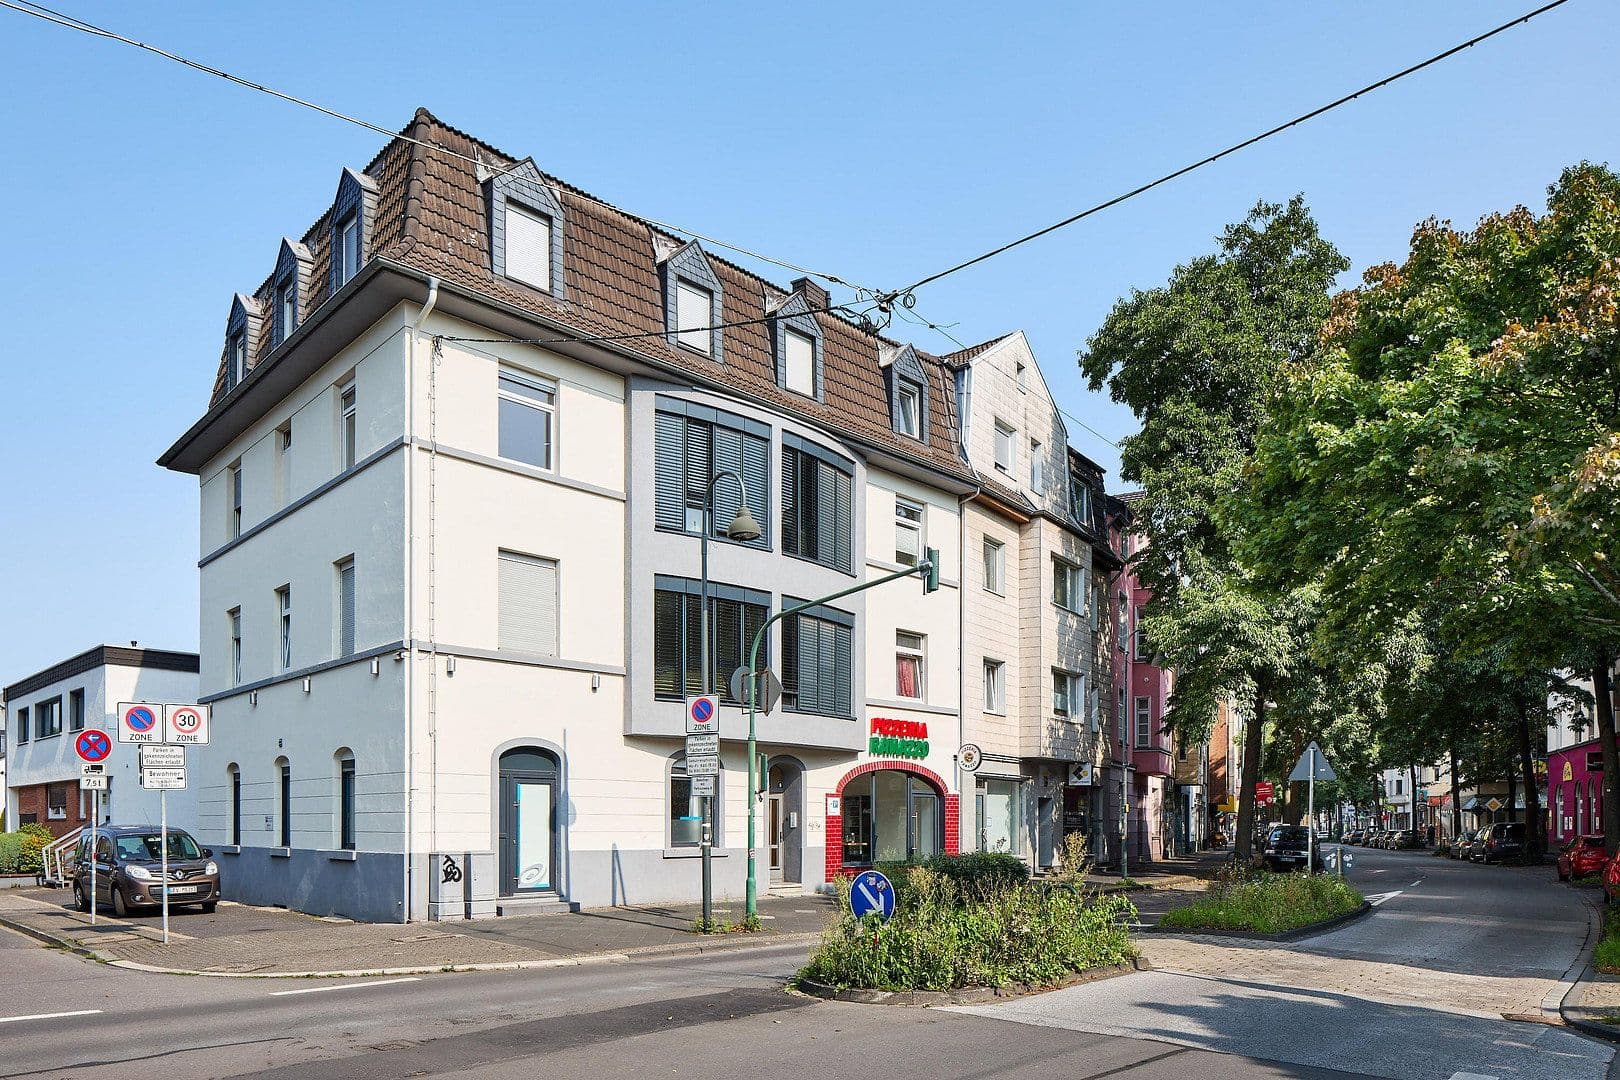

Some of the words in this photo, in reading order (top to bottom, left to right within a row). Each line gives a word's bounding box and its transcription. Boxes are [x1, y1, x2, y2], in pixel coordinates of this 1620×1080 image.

[178, 714, 196, 727] 30
[694, 723, 711, 731] ZONE
[871, 717, 928, 739] PIZZERIA
[129, 733, 152, 741] ZONE
[176, 734, 198, 742] ZONE
